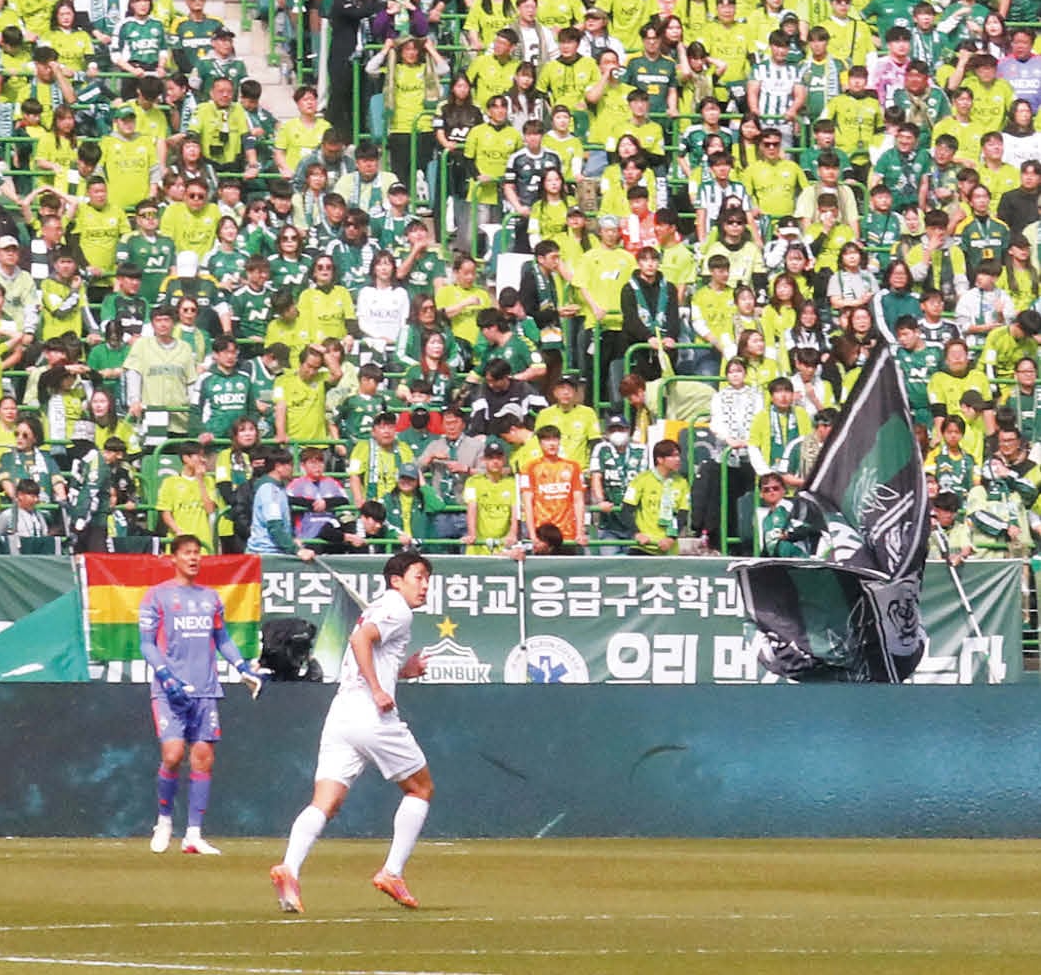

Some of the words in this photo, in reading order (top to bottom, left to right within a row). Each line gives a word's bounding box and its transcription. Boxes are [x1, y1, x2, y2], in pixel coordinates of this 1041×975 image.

[213, 392, 246, 405] NEXO
[538, 481, 571, 494] NEXO
[173, 615, 213, 631] NEXO
[421, 665, 488, 683] EONBUK
